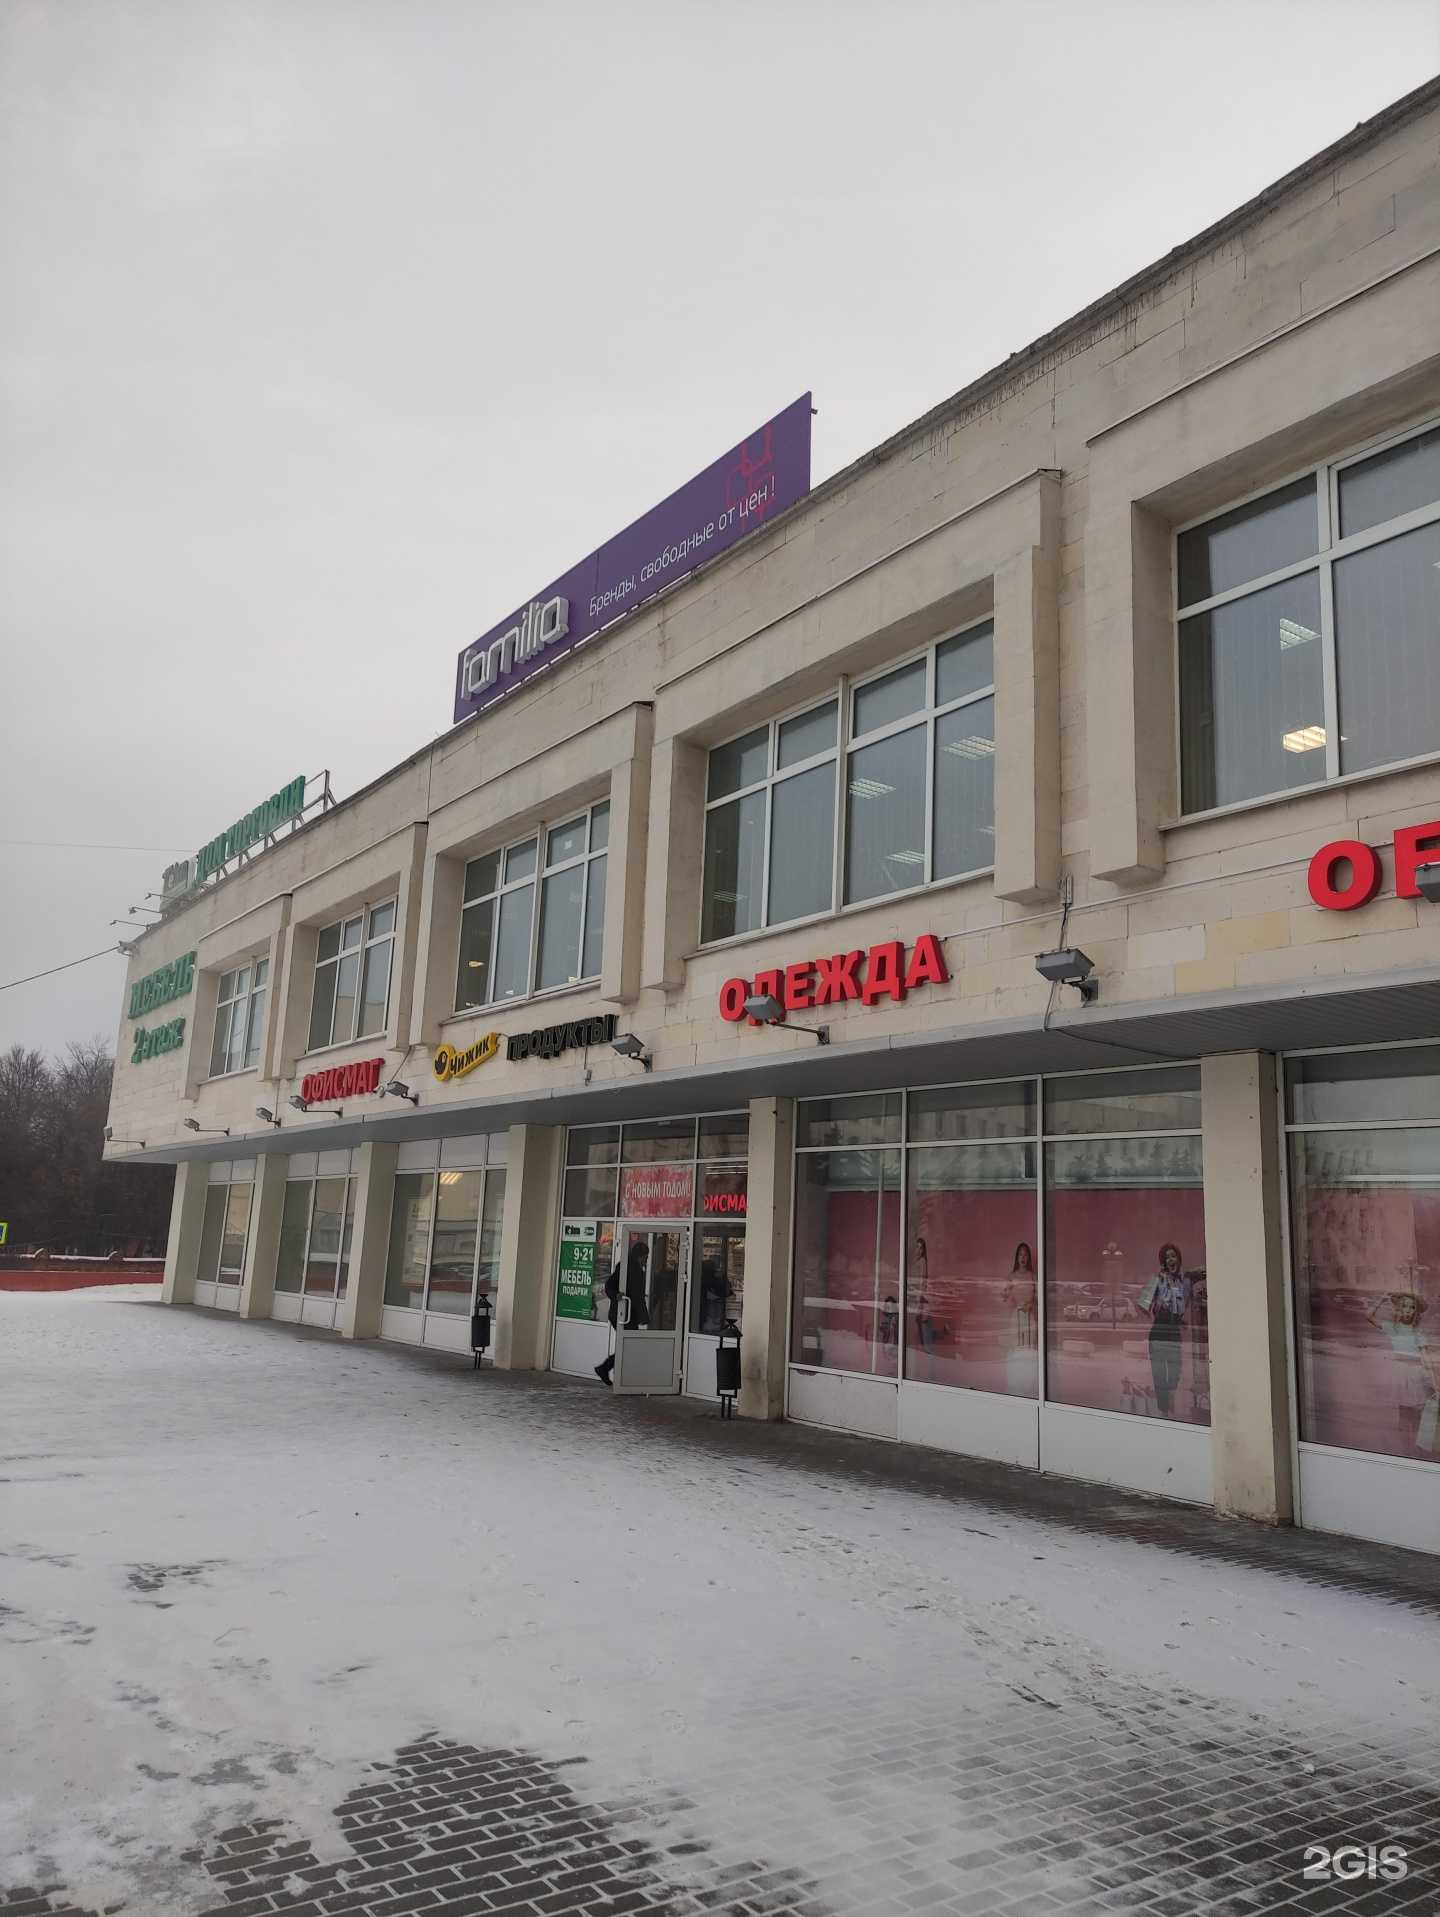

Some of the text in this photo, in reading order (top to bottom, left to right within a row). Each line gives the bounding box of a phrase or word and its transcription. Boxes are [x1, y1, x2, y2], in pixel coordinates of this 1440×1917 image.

[589, 575, 637, 616] Бренды,
[640, 521, 714, 582] свободные
[718, 507, 736, 530] от
[461, 596, 568, 700] familia
[128, 951, 197, 1019] МЕБЕЛЬ
[719, 934, 951, 1026] ОДЕЖДА
[507, 1014, 618, 1061] ПРОДУКТЫ
[302, 1058, 385, 1104] ОФИСМАГ
[625, 1182, 691, 1198] С НОВЫМ ГОДОМ!
[561, 1269, 592, 1286] МЕБЕЛЬ
[562, 1285, 588, 1297] ПОДАРКИ
